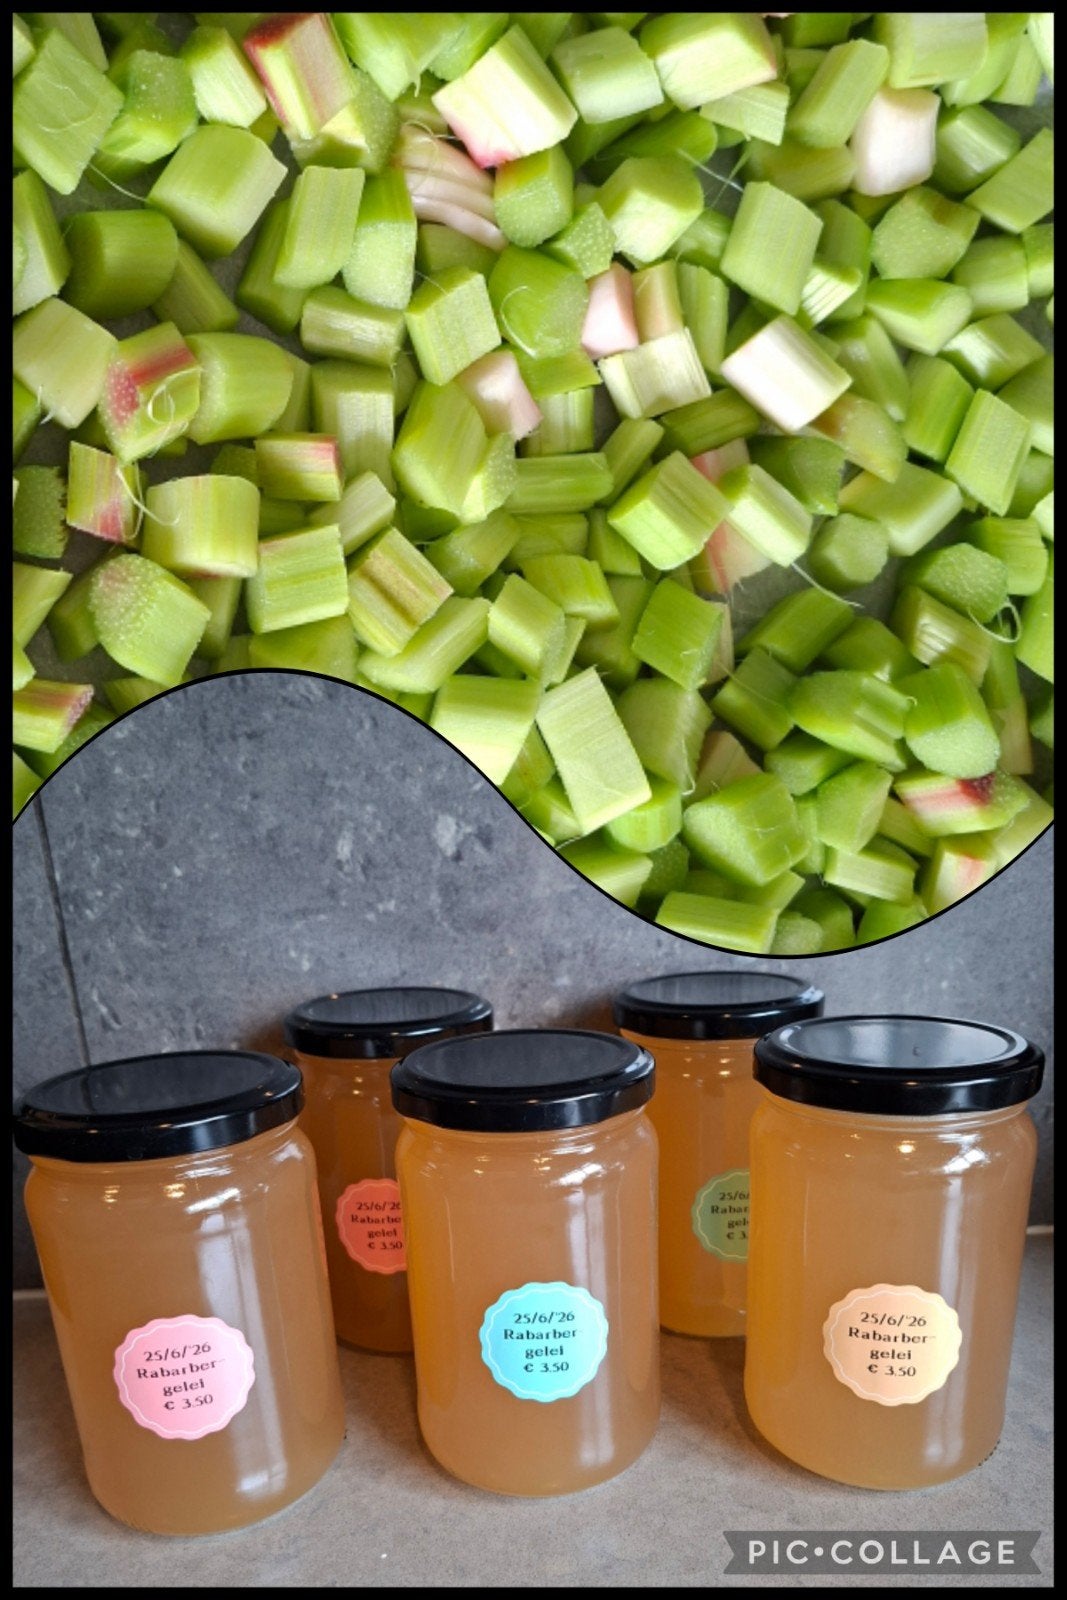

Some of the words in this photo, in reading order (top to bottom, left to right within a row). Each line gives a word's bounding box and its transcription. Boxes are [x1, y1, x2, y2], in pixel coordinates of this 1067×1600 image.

[367, 1228, 397, 1238] gelei
[524, 1344, 564, 1359] gelei
[869, 1348, 911, 1360] gelei
[523, 1362, 534, 1372] €
[540, 1361, 569, 1372] 3.50
[867, 1363, 878, 1373] €
[884, 1365, 916, 1376] 3.50
[162, 1378, 205, 1396] gelei
[163, 1400, 175, 1410] €
[181, 1393, 213, 1409] 3.50
